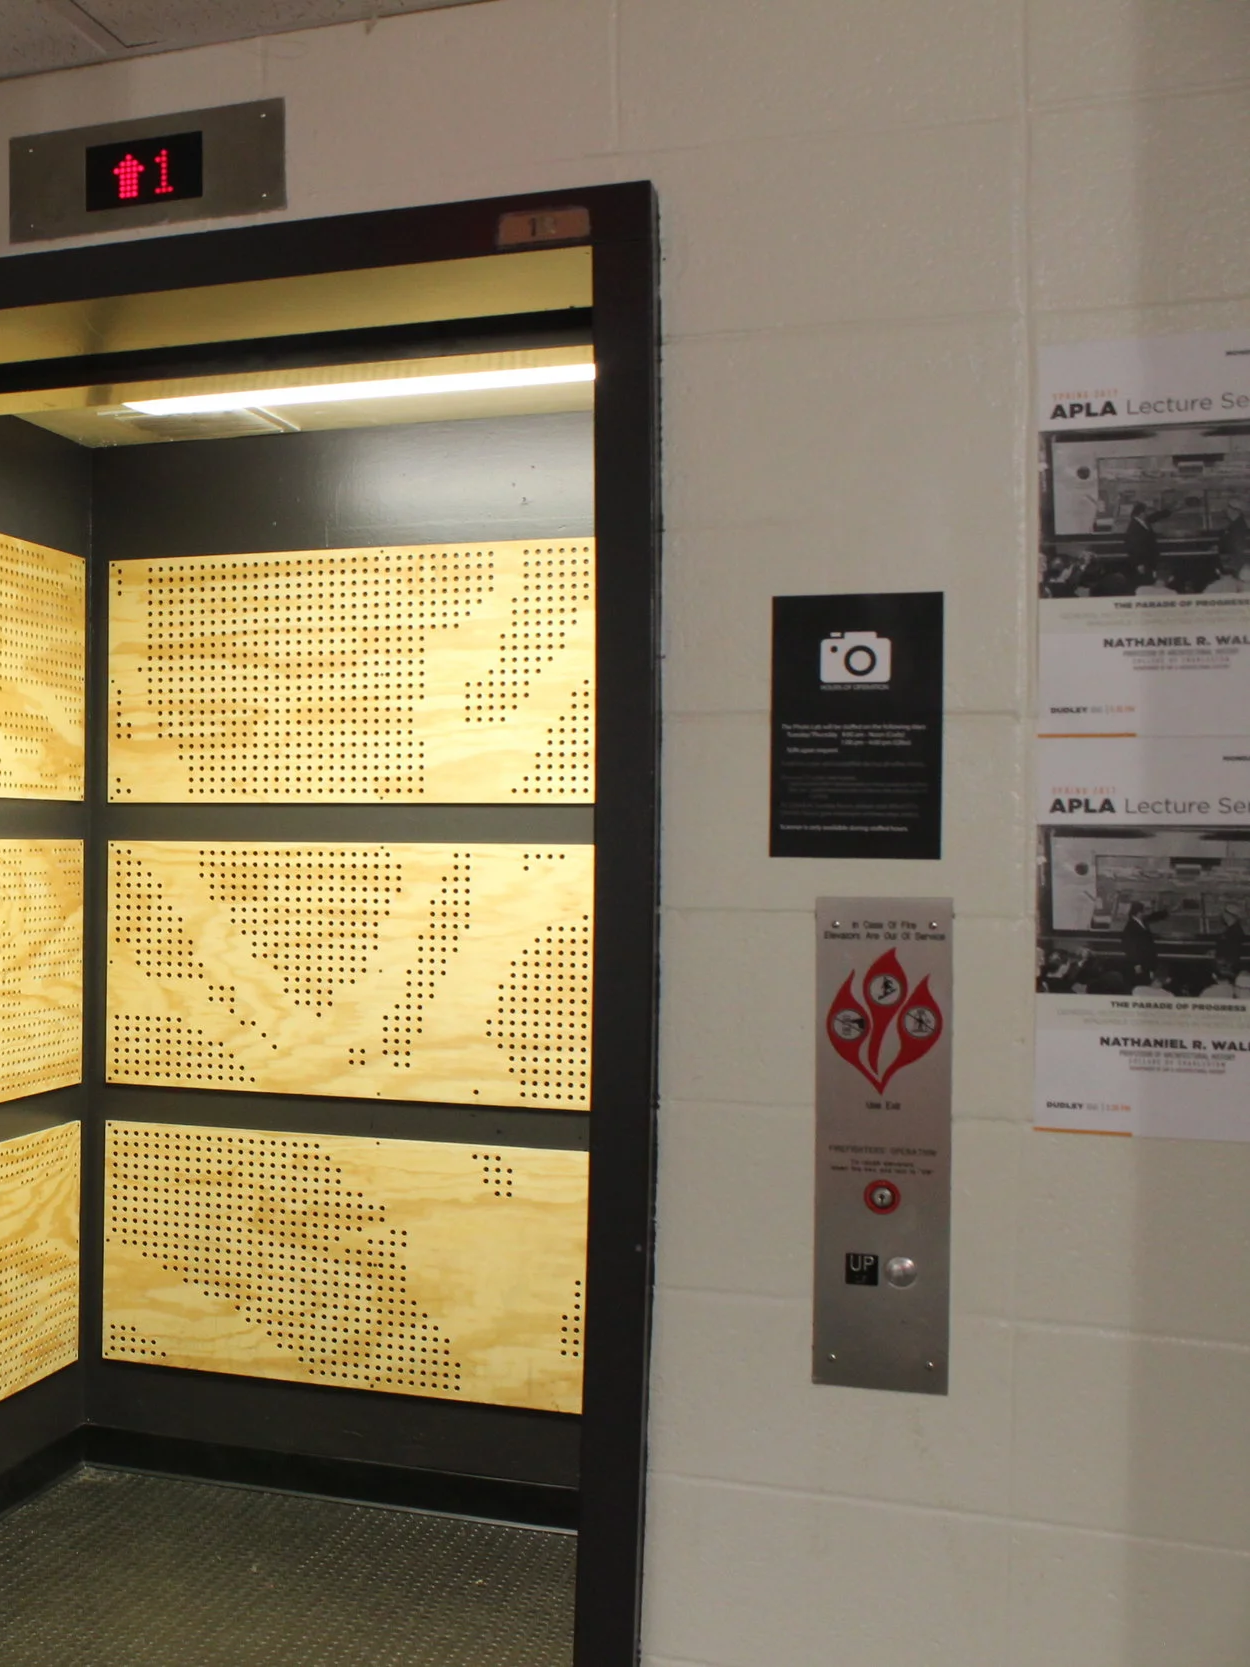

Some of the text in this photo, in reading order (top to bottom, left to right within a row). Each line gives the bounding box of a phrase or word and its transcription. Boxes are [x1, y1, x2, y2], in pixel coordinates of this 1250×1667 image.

[154, 149, 174, 194] 1
[1050, 400, 1117, 420] APLA
[1126, 396, 1212, 415] Lecture
[1103, 636, 1192, 648] NATHANIEL
[1196, 635, 1211, 647] R.
[1049, 798, 1116, 814] APLA
[1124, 798, 1210, 814] Lecture
[1100, 1036, 1188, 1049] NATHANIEL
[1192, 1039, 1207, 1050] R.
[850, 1254, 875, 1272] UP
